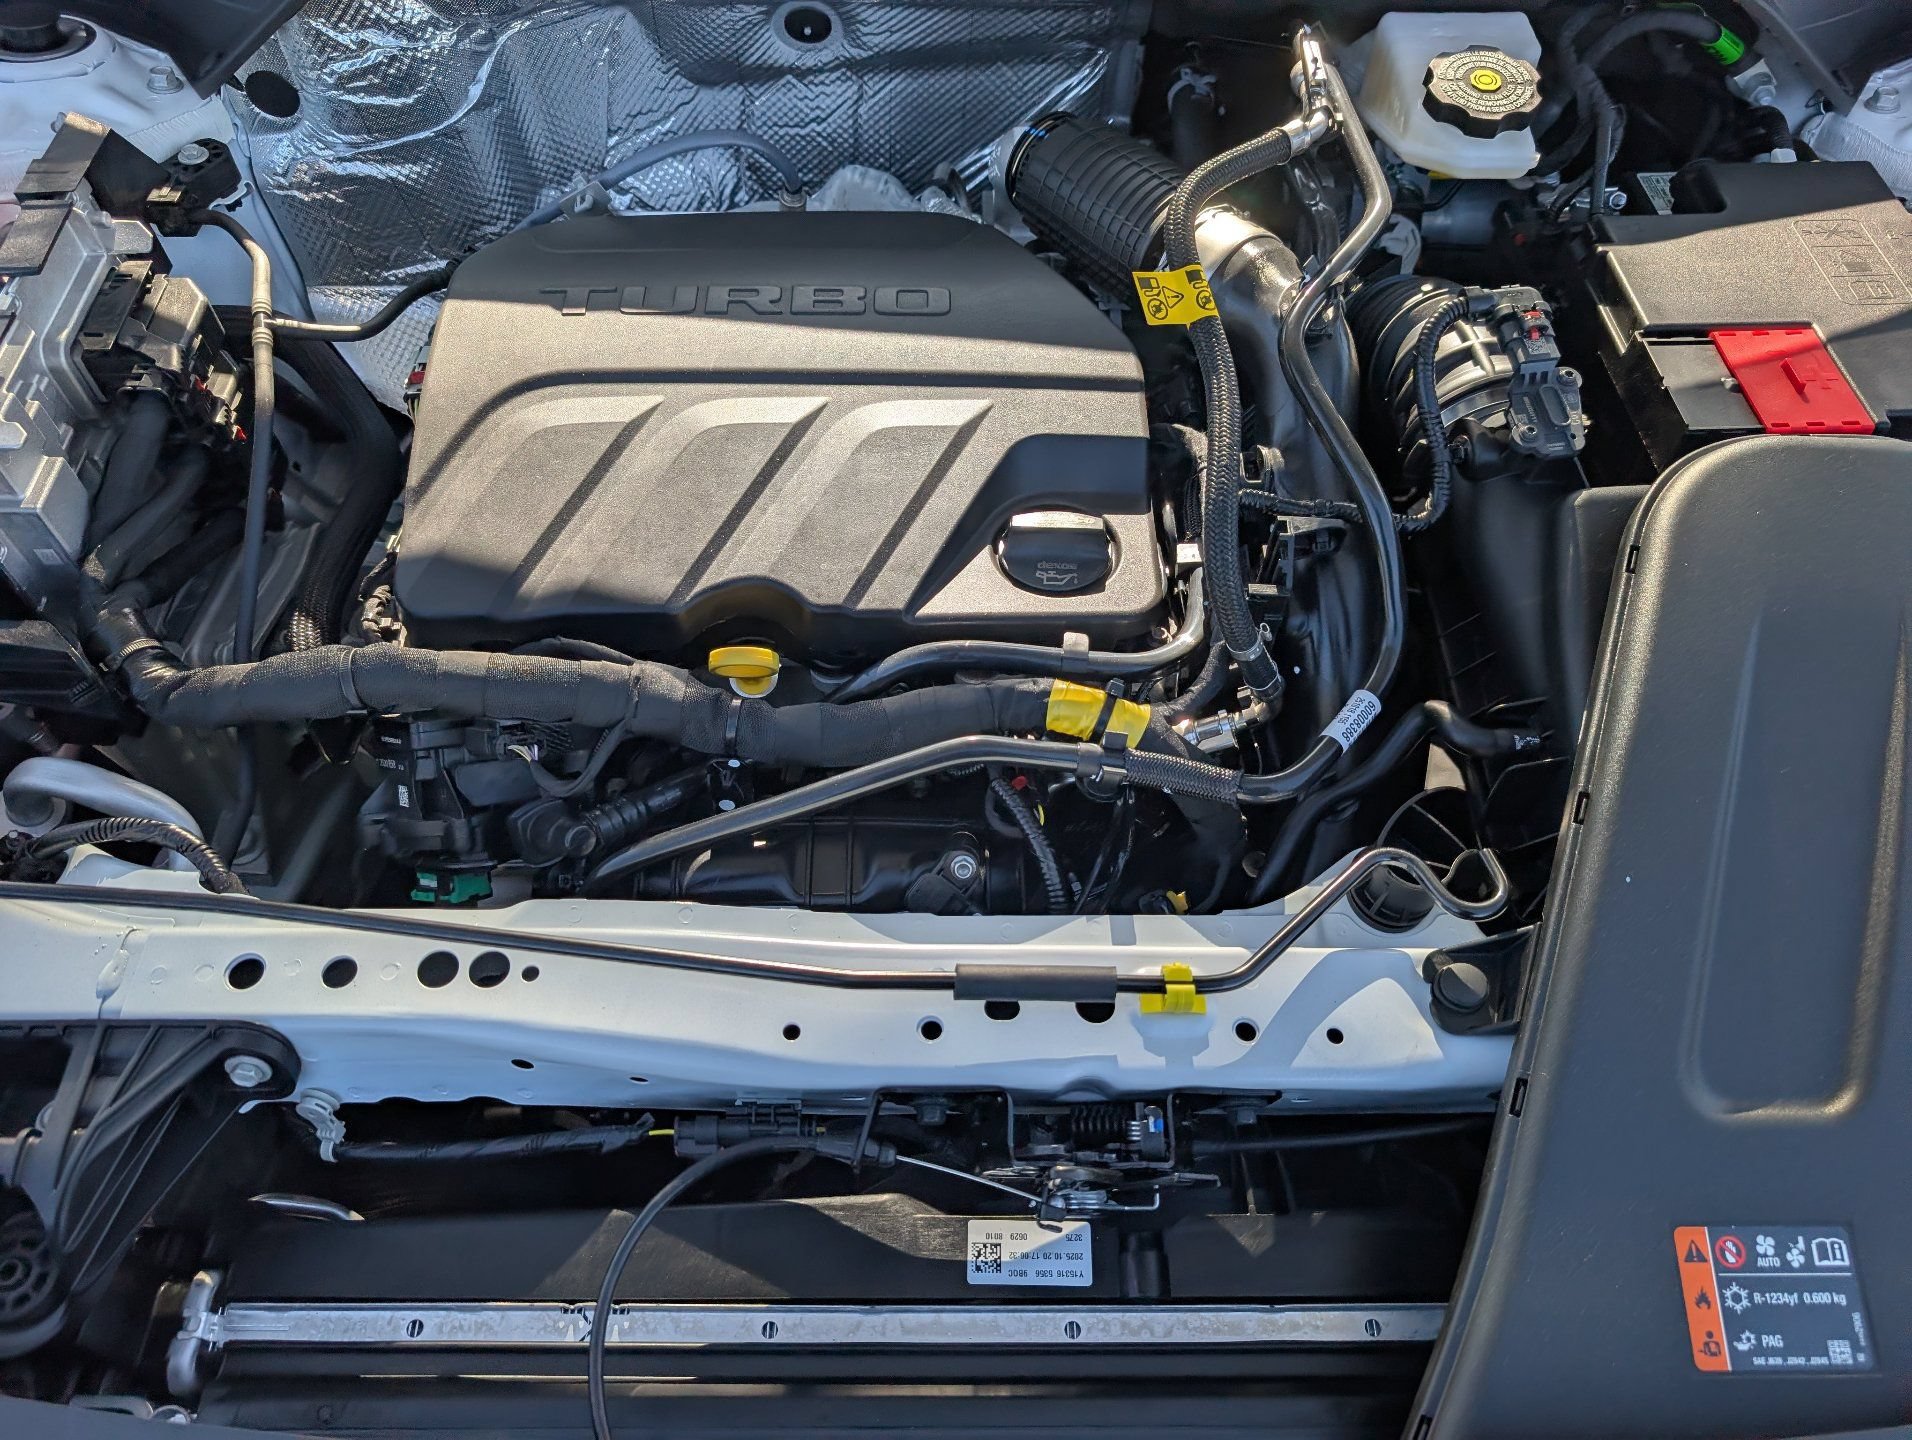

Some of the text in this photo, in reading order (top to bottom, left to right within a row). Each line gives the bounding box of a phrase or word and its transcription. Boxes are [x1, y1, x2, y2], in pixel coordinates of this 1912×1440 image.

[1467, 102, 1486, 111] FROM
[539, 285, 952, 317] TURBO
[1342, 701, 1376, 742] 60008388
[1065, 1233, 1083, 1242] 3275
[1042, 1252, 1084, 1261] 2025.10.20
[1757, 1257, 1781, 1268] AUTO
[1754, 1292, 1847, 1306] R-1234yf 0.600 kg
[1761, 1334, 1784, 1349] PAG
